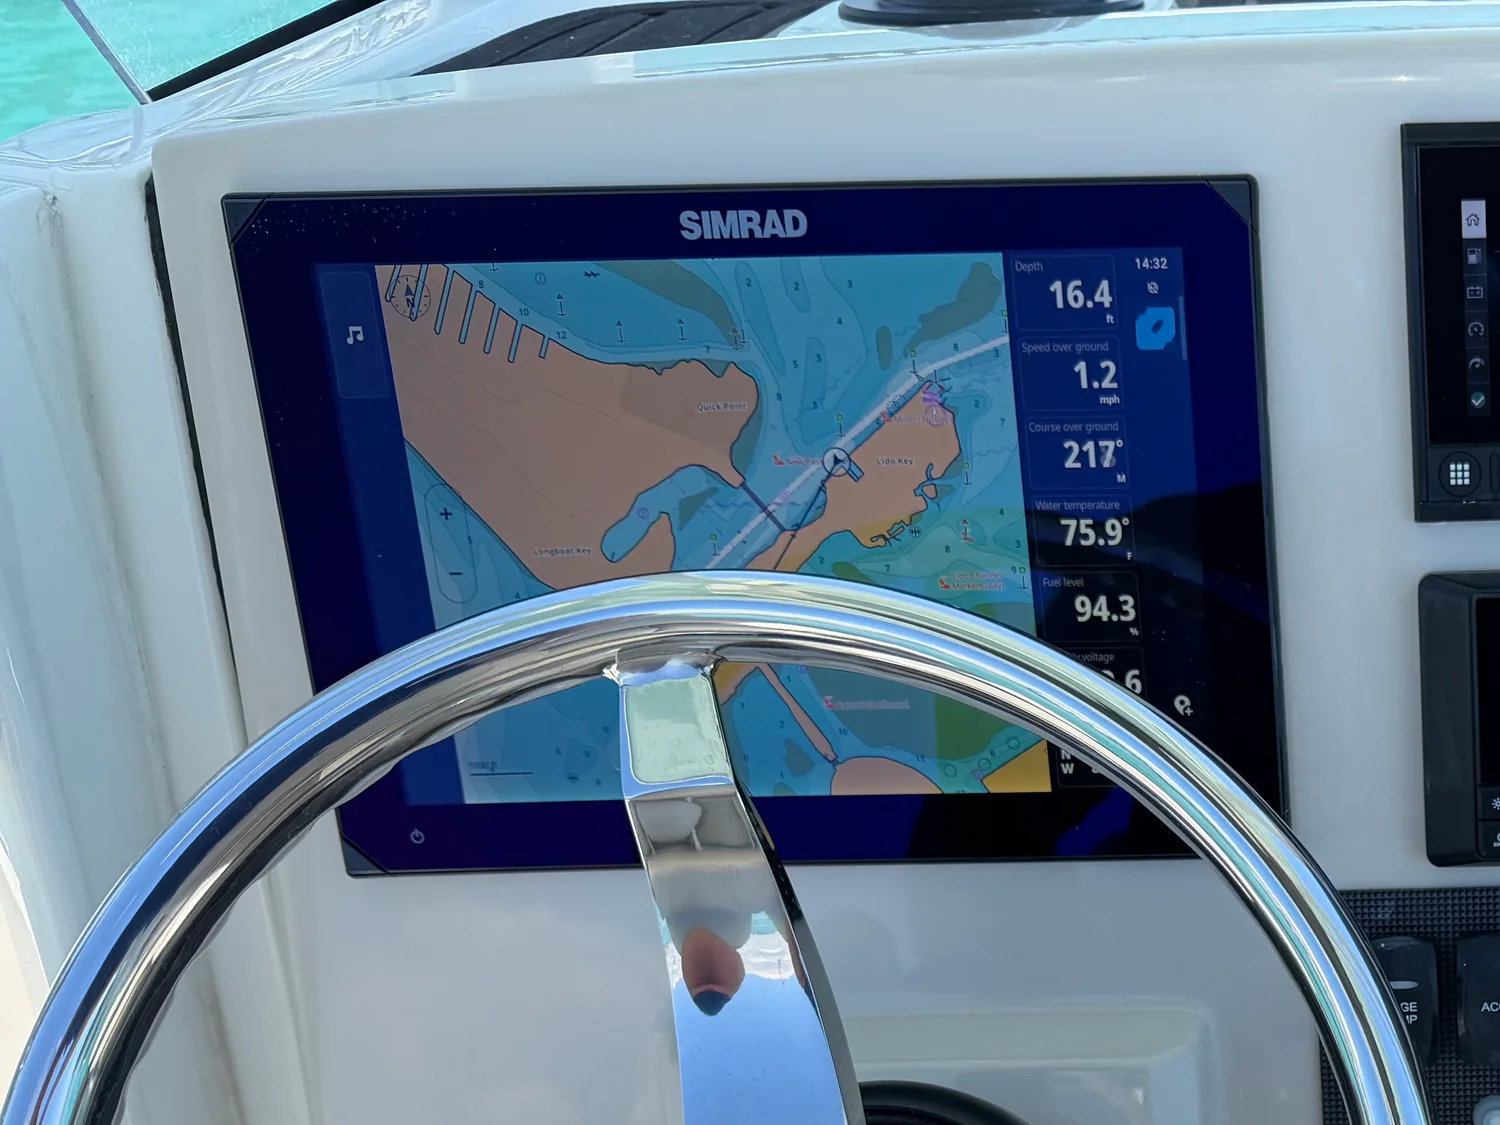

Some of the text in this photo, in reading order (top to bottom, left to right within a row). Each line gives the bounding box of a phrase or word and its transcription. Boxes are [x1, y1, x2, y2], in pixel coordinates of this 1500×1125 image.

[679, 209, 808, 241] SIMRAD
[1015, 261, 1044, 274] Depth
[1135, 258, 1168, 270] 14:32
[1049, 279, 1113, 309] 16.4
[519, 308, 530, 317] 10
[1106, 314, 1114, 324] ft
[557, 331, 567, 340] 12
[1021, 342, 1109, 354] Speed over ground
[1074, 360, 1118, 389] 1.2
[1100, 394, 1120, 406] mph
[1028, 421, 1119, 434] Course over ground
[877, 457, 915, 467] Lido Key
[1117, 474, 1126, 483] M
[1035, 500, 1120, 513] Water temperature
[1060, 518, 1130, 547] 75.9°
[1043, 577, 1085, 588] Fuel level
[1074, 594, 1136, 622] 94.3
[1129, 627, 1139, 636] %
[1081, 651, 1115, 664] voltage
